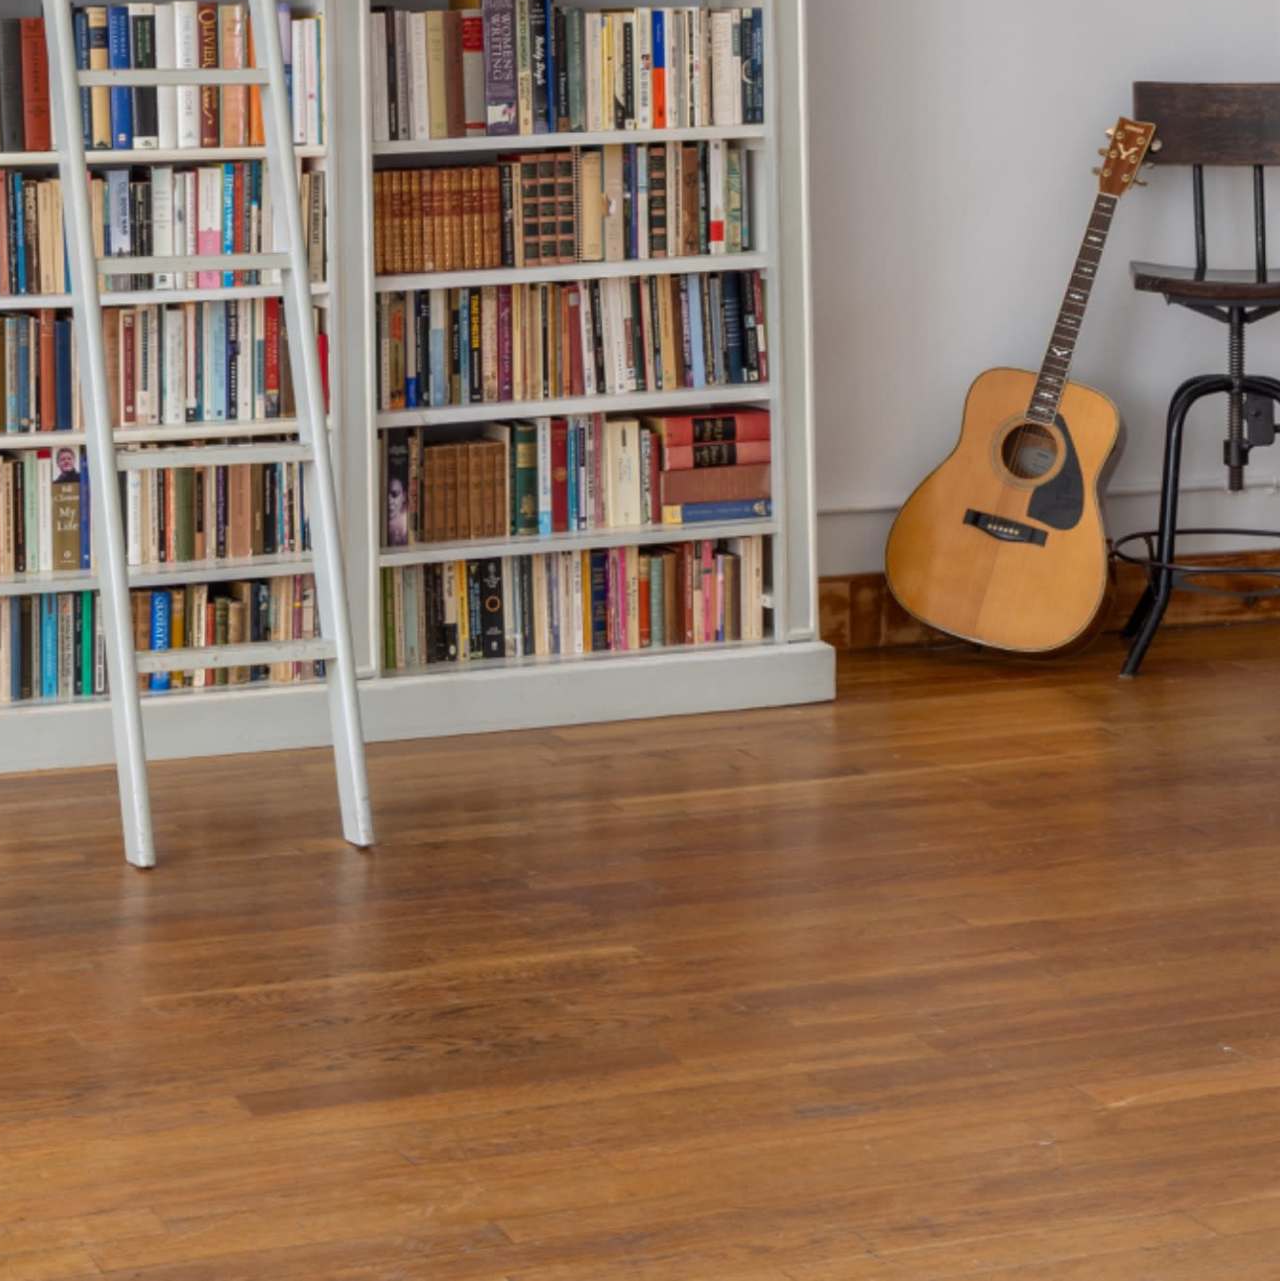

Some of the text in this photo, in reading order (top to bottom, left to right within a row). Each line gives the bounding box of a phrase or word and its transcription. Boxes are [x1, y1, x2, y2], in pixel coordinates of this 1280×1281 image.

[201, 9, 219, 66] OLIVIER
[490, 14, 503, 81] WRITING
[502, 14, 514, 81] WOMEN'S
[534, 35, 546, 86] Roddy Doyle
[56, 519, 80, 531] Life
[59, 507, 76, 521] My
